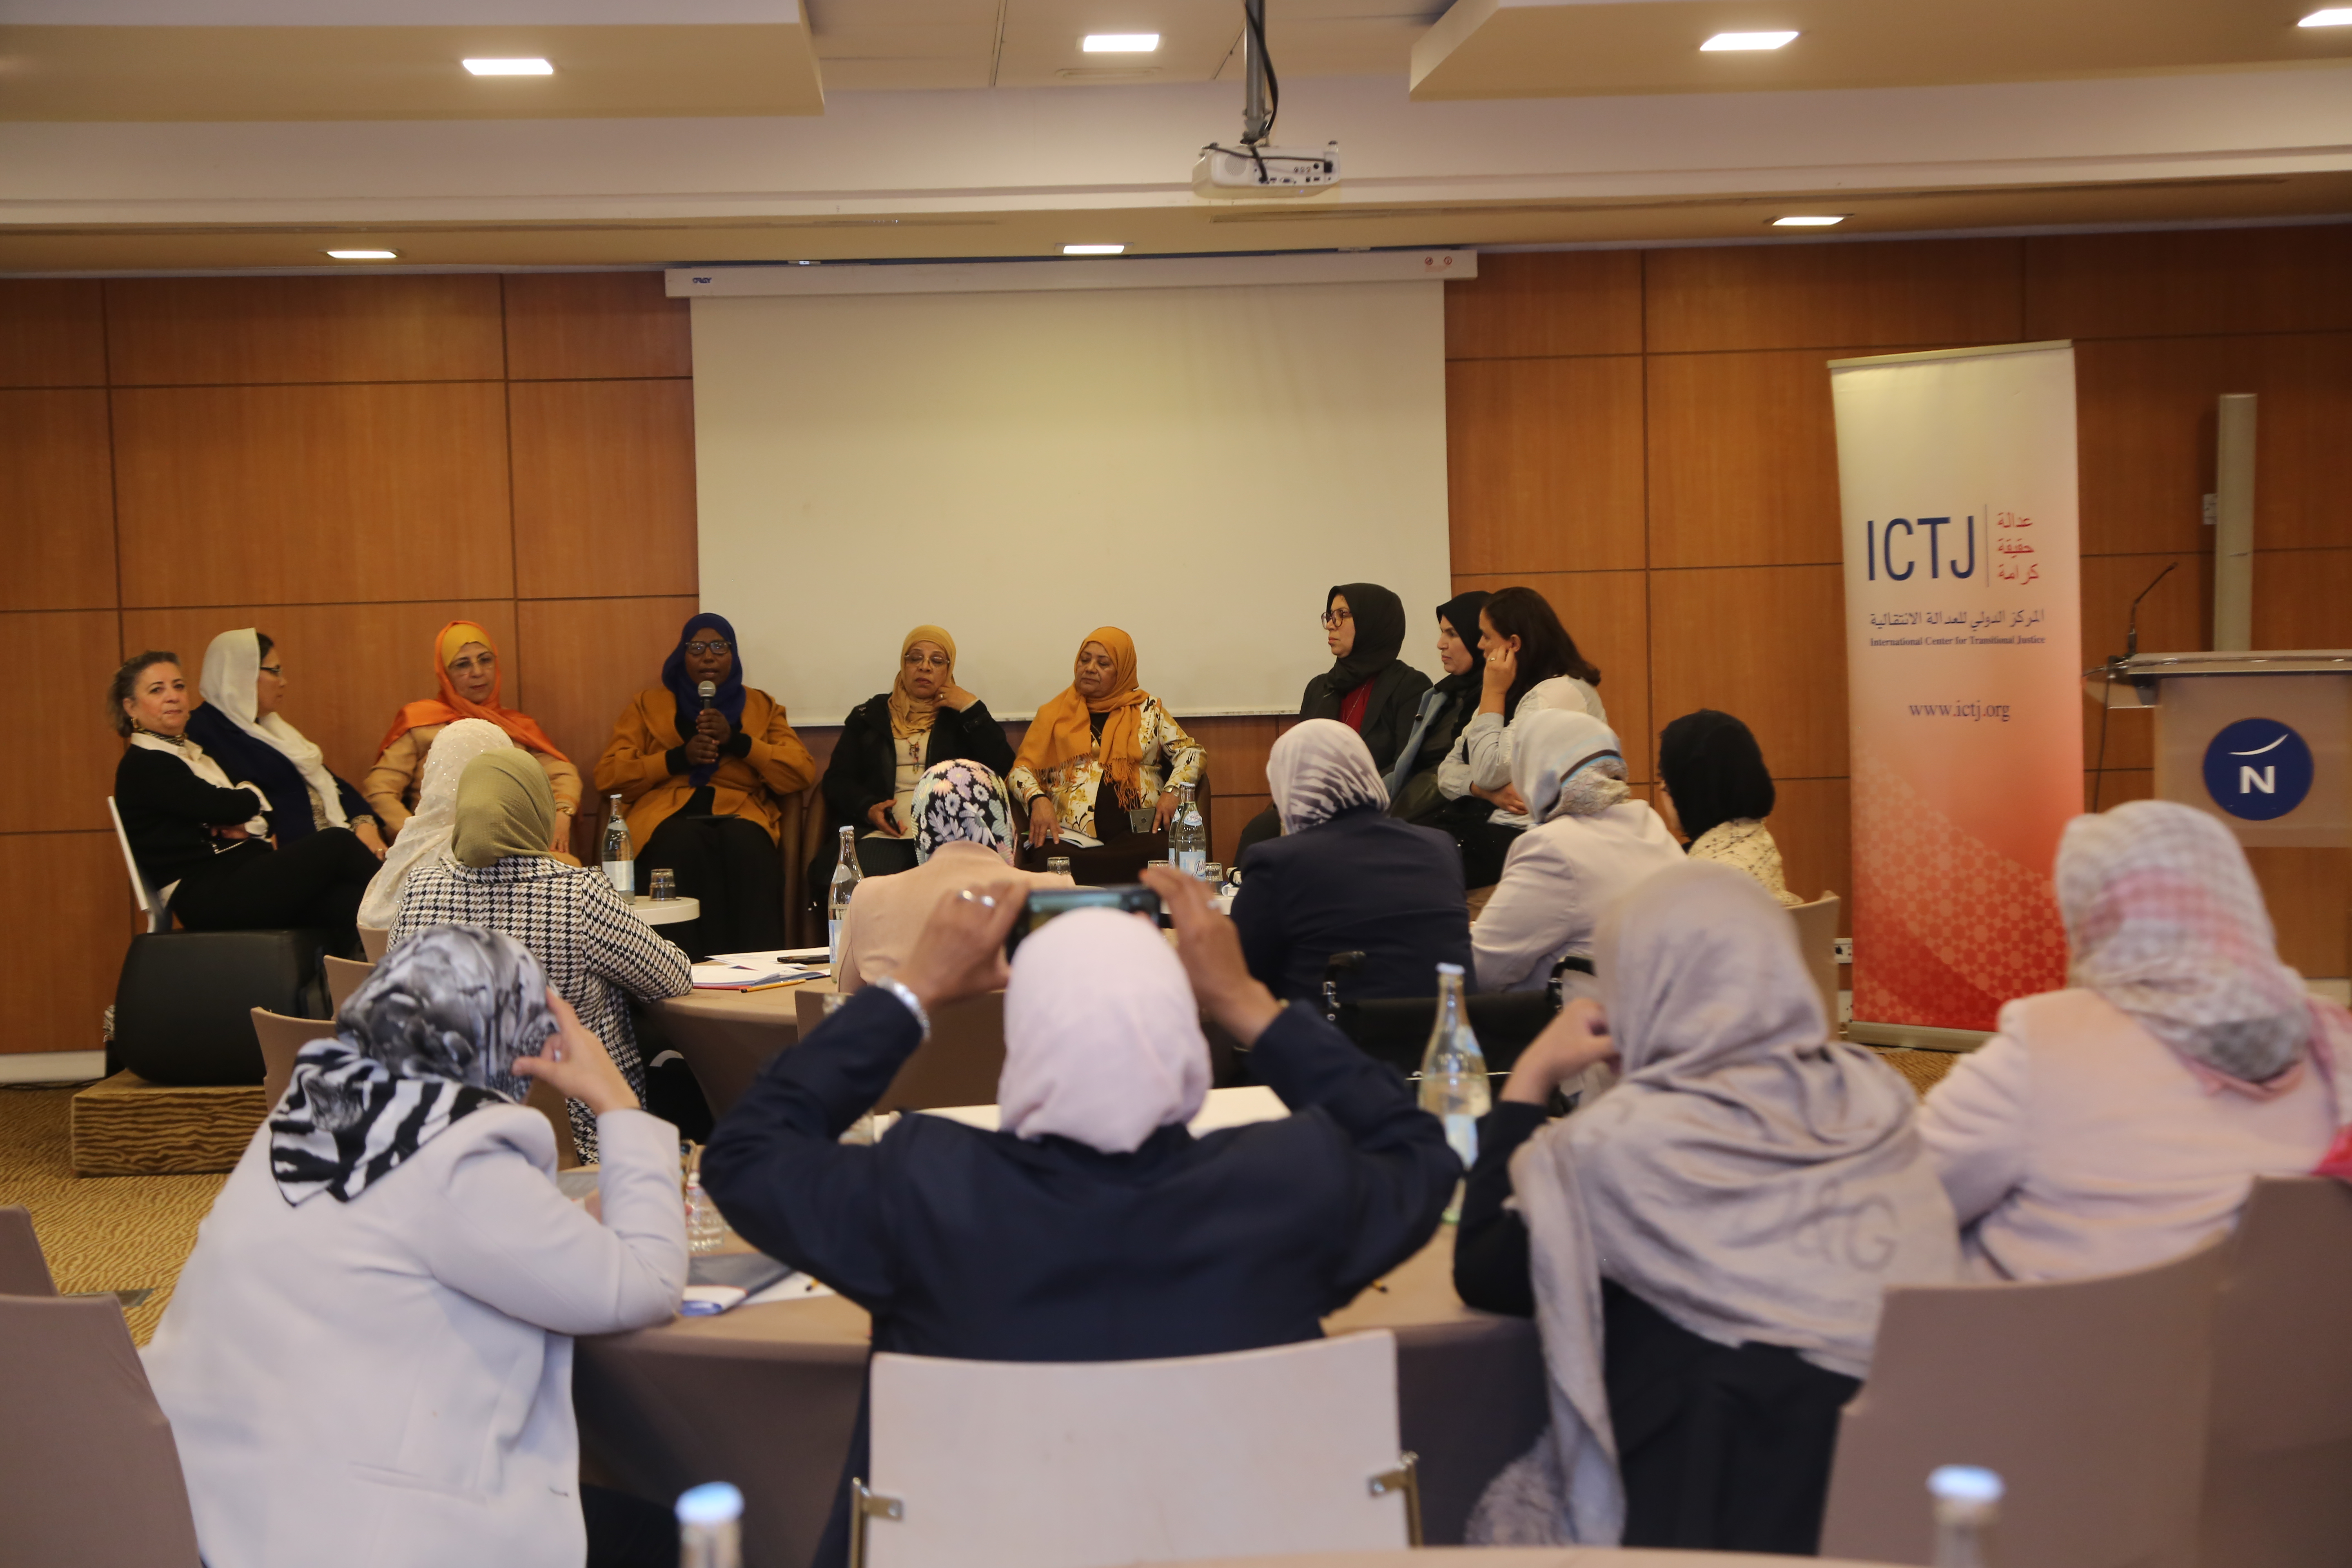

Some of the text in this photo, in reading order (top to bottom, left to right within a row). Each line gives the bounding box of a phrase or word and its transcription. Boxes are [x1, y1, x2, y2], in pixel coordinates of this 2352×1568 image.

[1997, 512, 2033, 528] عدالة
[1867, 516, 1975, 581] ICTJ
[1997, 538, 2035, 559] حقيقة
[1997, 563, 2039, 585] كرامة
[1870, 609, 2045, 632] المركز الدولي للعدالة الانتقالية
[1870, 635, 2046, 647] International Center for Transitional Justice
[1909, 699, 2011, 722] www.ictj.org
[2239, 766, 2275, 794] N
